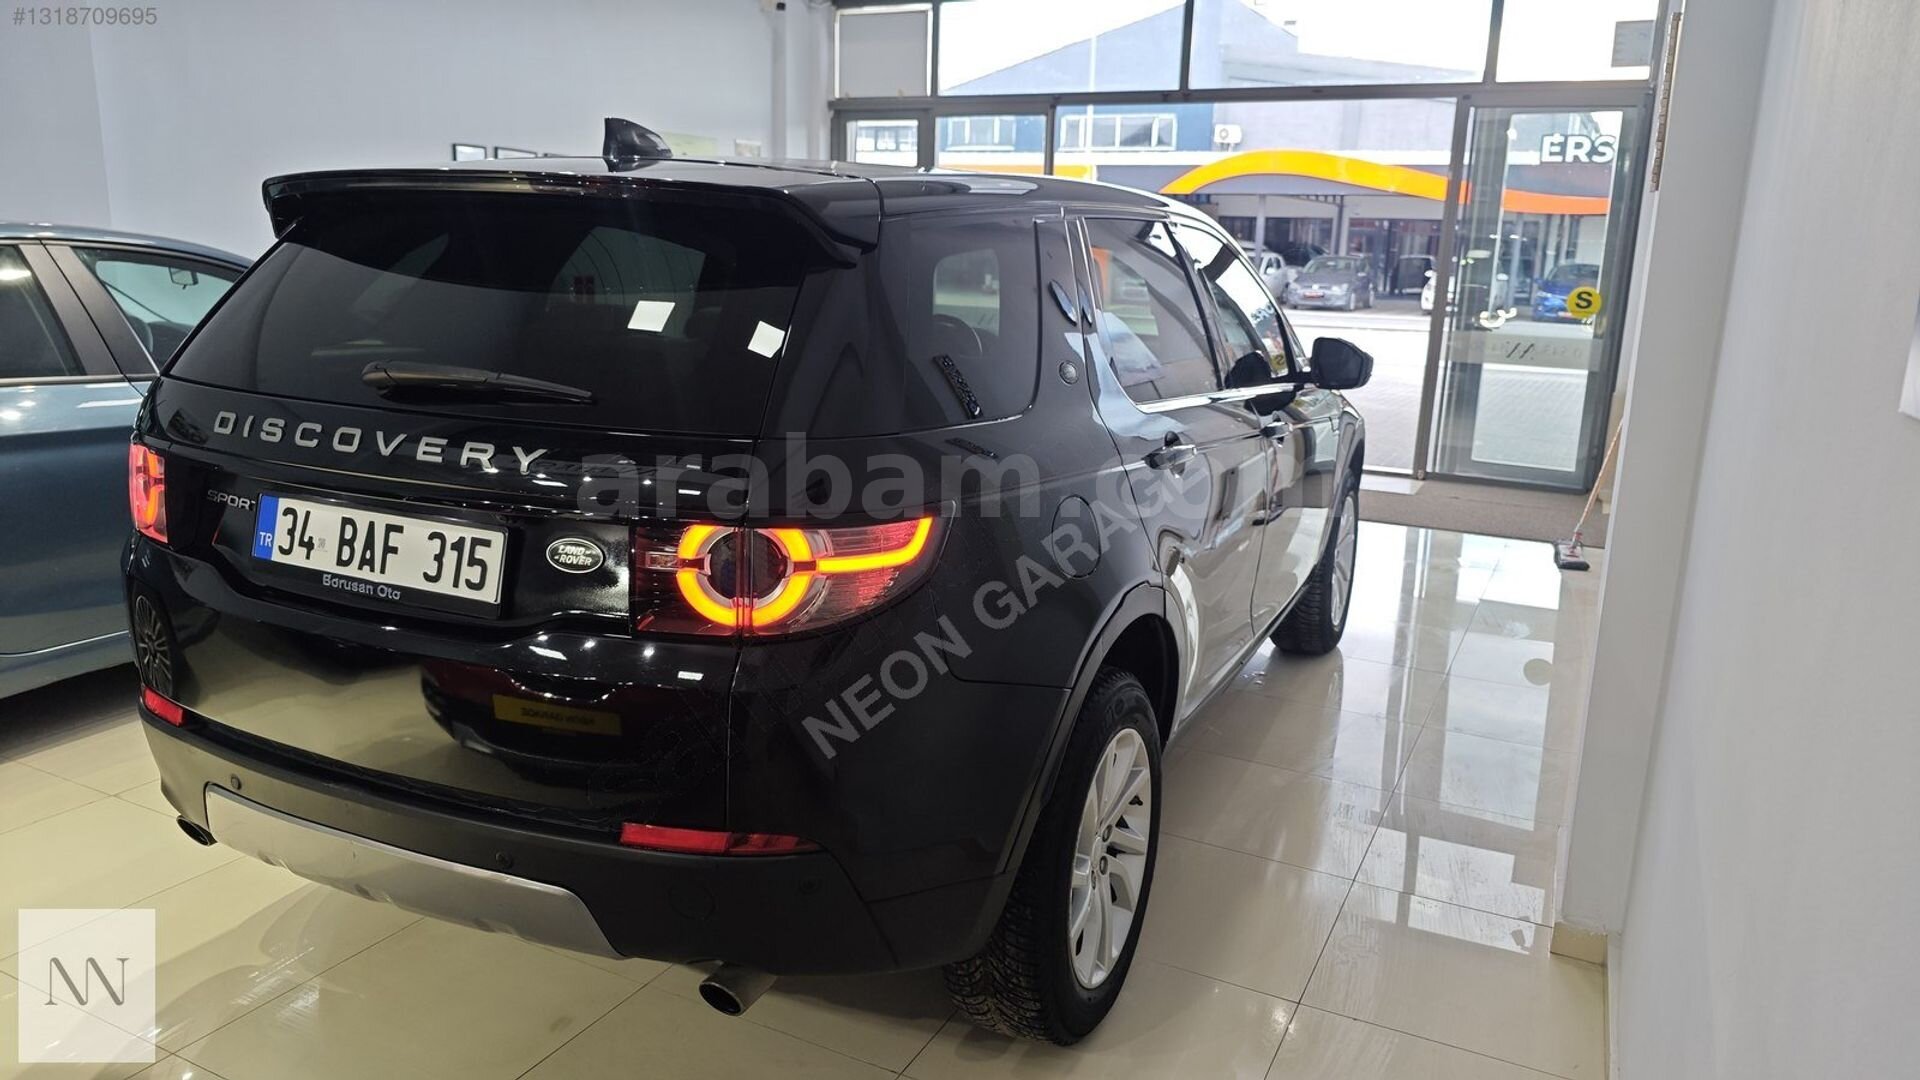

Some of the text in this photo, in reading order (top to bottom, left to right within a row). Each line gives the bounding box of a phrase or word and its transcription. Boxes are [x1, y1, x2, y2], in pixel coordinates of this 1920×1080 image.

[1575, 291, 1593, 309] S
[213, 411, 548, 475] DISCOVERY
[259, 532, 273, 547] TR
[278, 507, 492, 591] 34 BAF 315
[558, 545, 585, 556] LAND
[559, 554, 593, 566] ROVER
[322, 573, 401, 600] Borusan Oto
